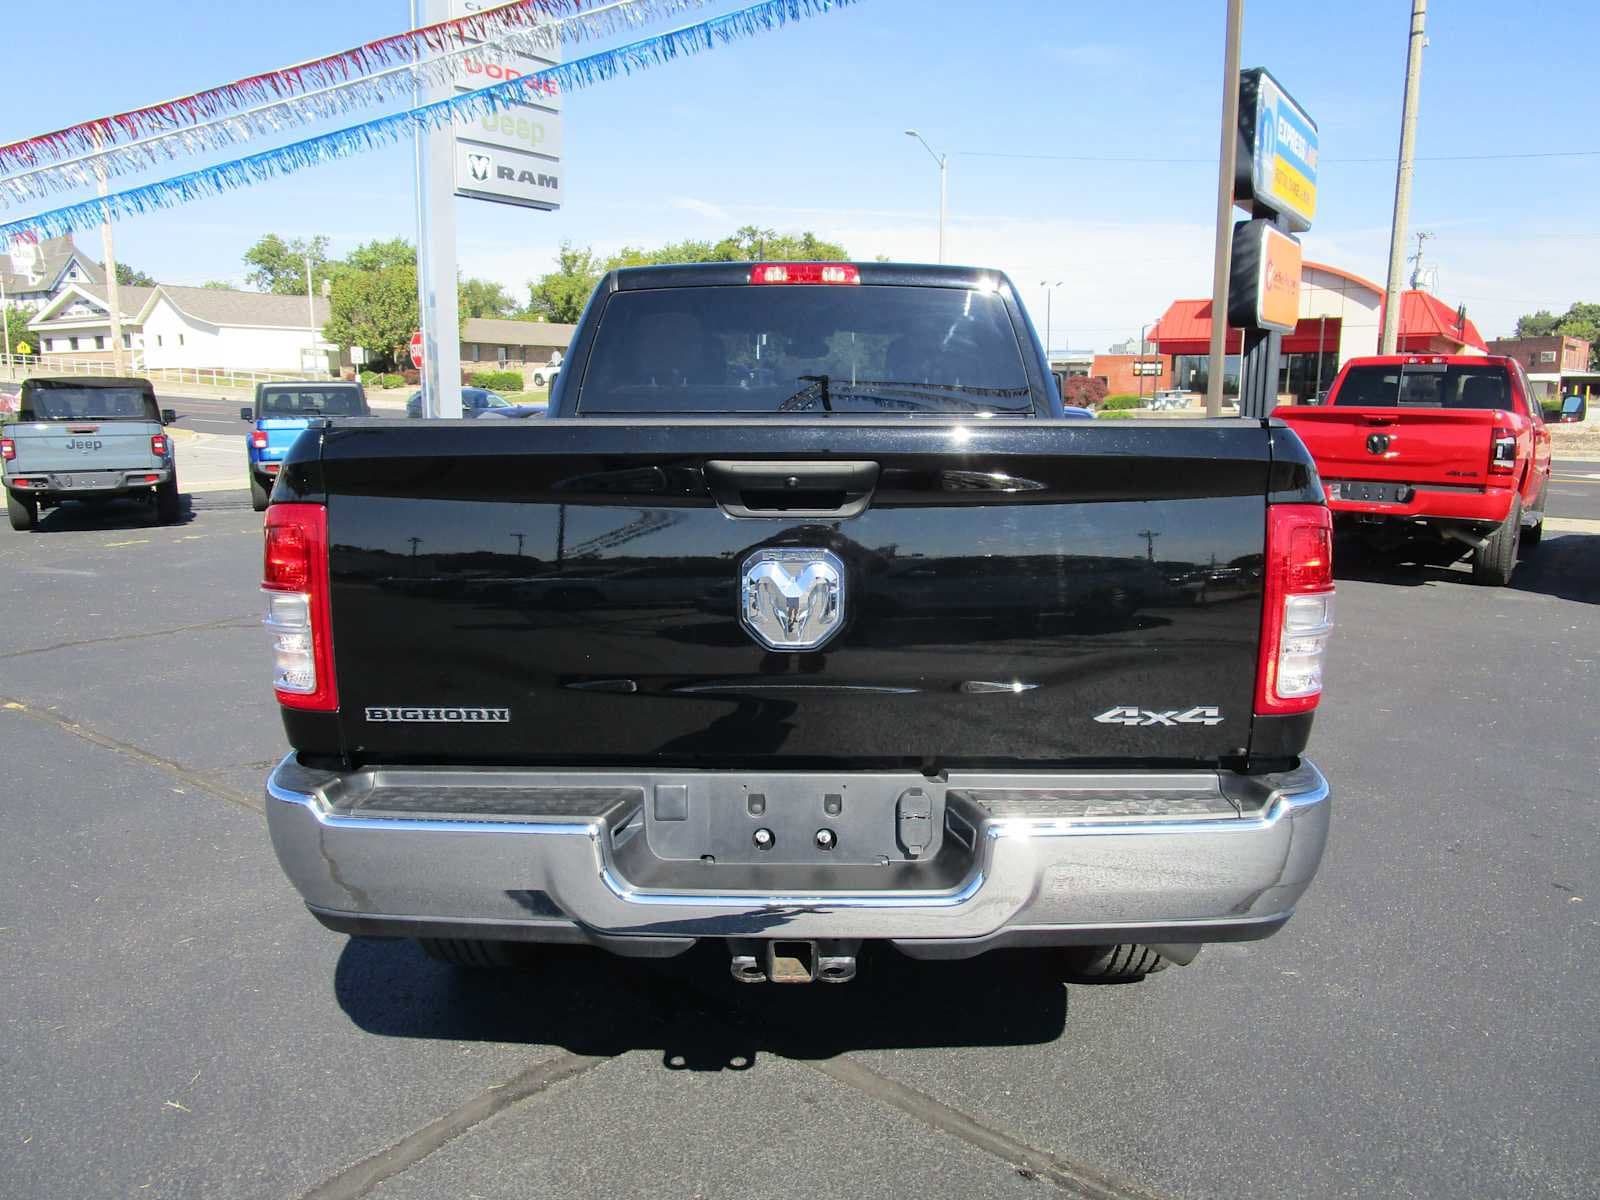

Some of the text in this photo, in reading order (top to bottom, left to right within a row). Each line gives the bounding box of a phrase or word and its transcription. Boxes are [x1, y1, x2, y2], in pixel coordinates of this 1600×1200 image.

[481, 110, 545, 146] Jeep
[496, 165, 558, 189] RAM
[66, 439, 102, 451] Jeep
[365, 707, 510, 722] BIGHORN
[1093, 706, 1224, 726] 4x4
